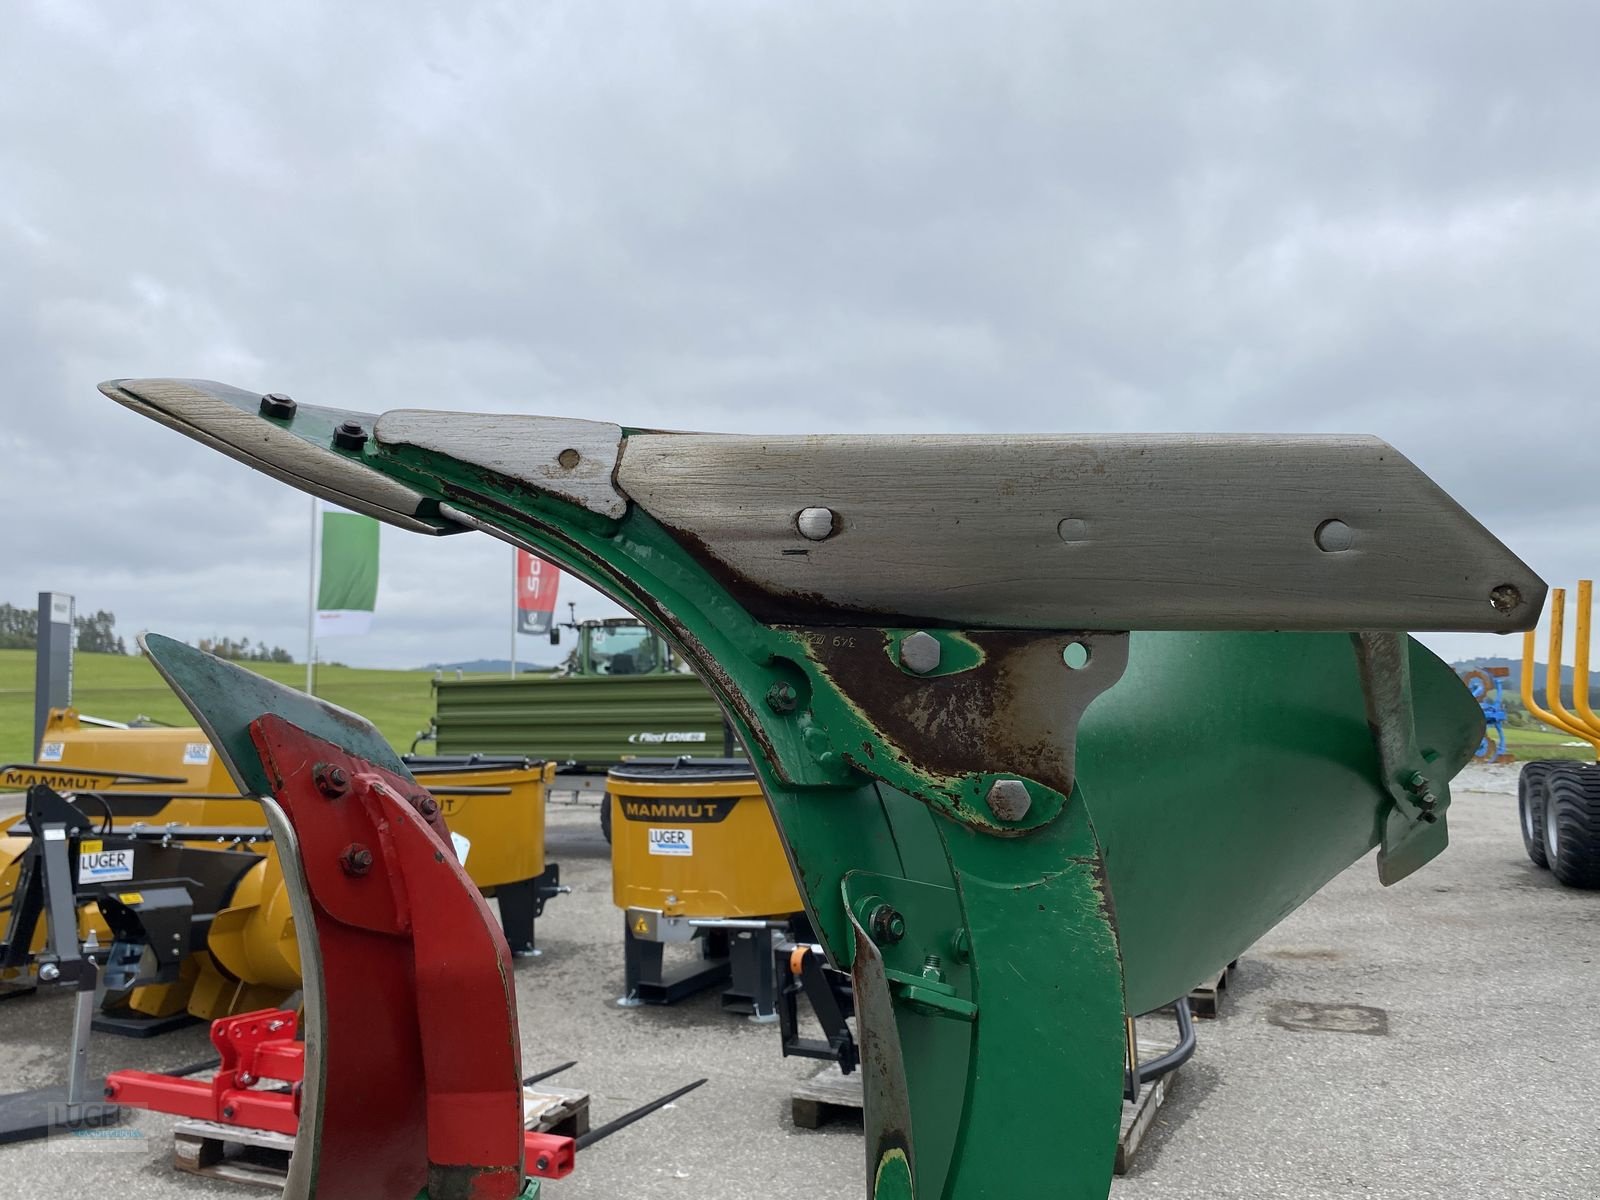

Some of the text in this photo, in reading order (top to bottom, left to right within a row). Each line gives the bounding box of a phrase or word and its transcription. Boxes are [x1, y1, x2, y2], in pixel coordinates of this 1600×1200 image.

[6, 772, 100, 790] MAMMUT
[626, 803, 717, 817] MAMMUT
[650, 830, 686, 844] LUGER
[82, 852, 128, 870] LUGER
